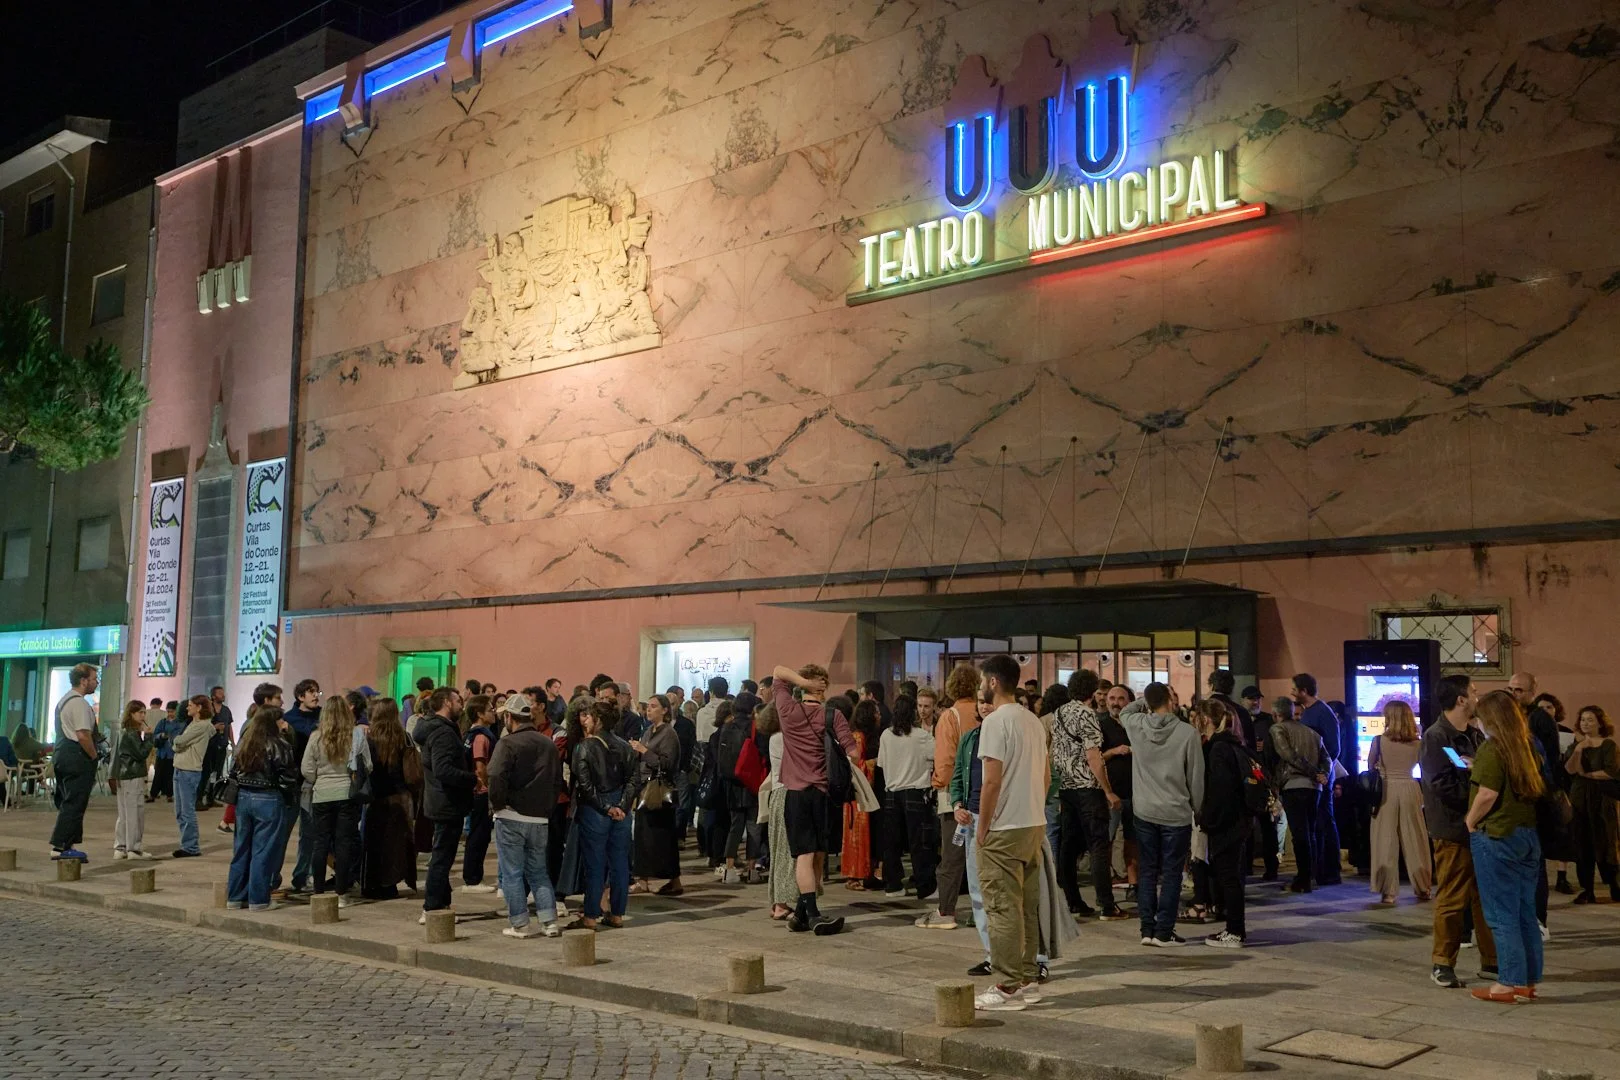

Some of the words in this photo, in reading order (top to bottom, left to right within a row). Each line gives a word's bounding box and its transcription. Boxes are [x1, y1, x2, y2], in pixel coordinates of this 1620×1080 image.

[859, 210, 985, 290] TEATRO
[1027, 149, 1241, 252] MUNICIPAL
[246, 521, 271, 534] Curtas
[245, 535, 259, 546] Vila
[244, 548, 255, 560] do
[254, 545, 279, 558] Conde
[156, 558, 177, 570] Conde
[254, 573, 275, 585] 2024
[156, 584, 174, 595] 2024
[249, 590, 268, 598] Festival
[242, 598, 272, 607] Internacional
[247, 606, 266, 615] Cinema
